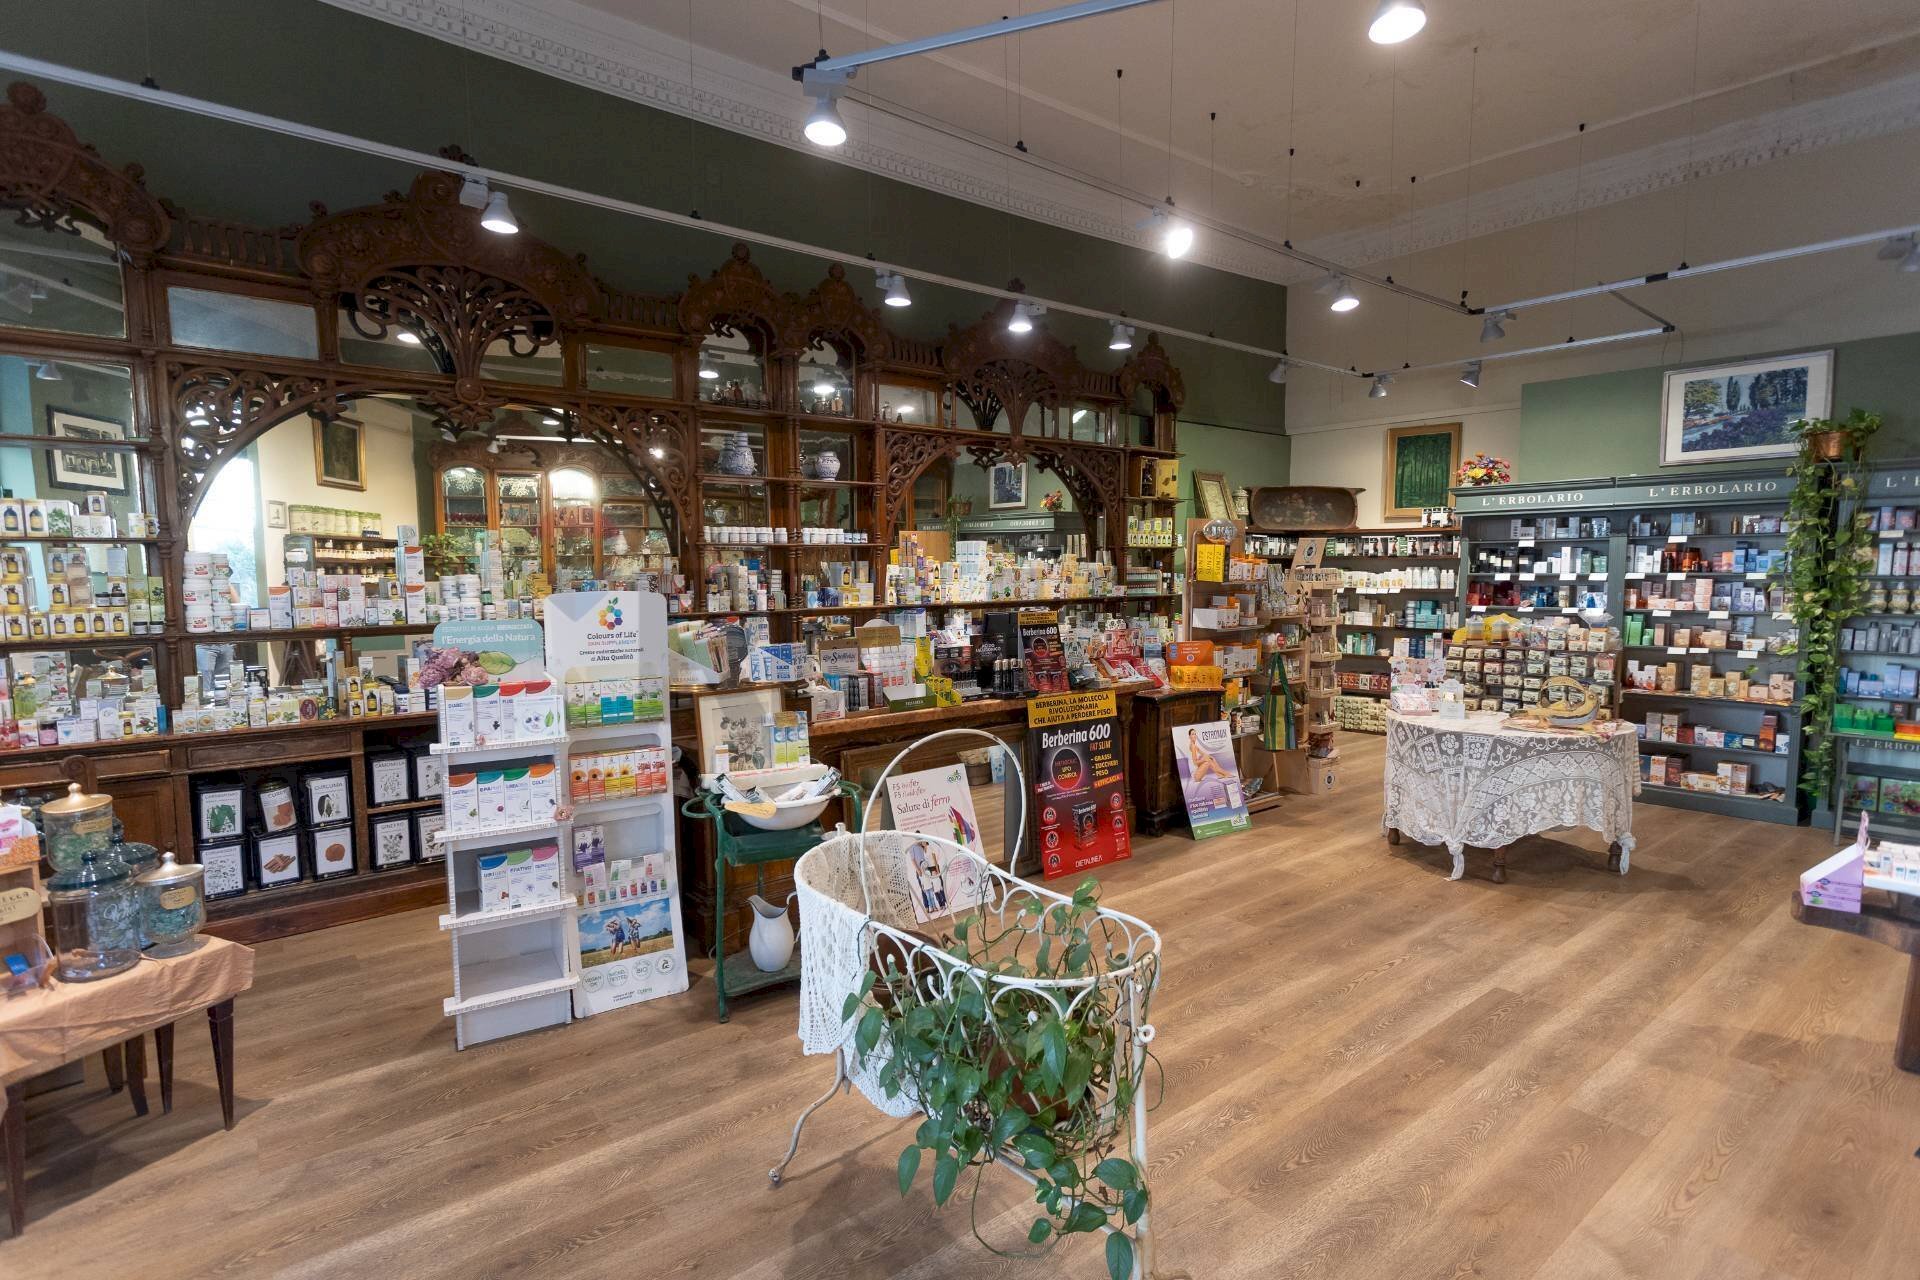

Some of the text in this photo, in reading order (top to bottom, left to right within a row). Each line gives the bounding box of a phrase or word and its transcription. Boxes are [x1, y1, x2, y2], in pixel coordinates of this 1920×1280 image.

[1650, 482, 1777, 497] L'ERBOLARIO
[1482, 492, 1584, 507] L'ERBOLARIO
[587, 632, 614, 640] Colours
[615, 631, 622, 639] of
[1046, 626, 1058, 635] 600
[1069, 697, 1077, 705] LA
[1078, 694, 1109, 704] MOLECOLA
[1048, 703, 1099, 715] RIVOLUZIONARIA
[1033, 716, 1046, 725] CHE
[1047, 714, 1065, 723] AIUTA
[1071, 709, 1097, 720] PERDERE
[1042, 723, 1111, 749] Berberina 600
[897, 794, 951, 815] Salute di ferro
